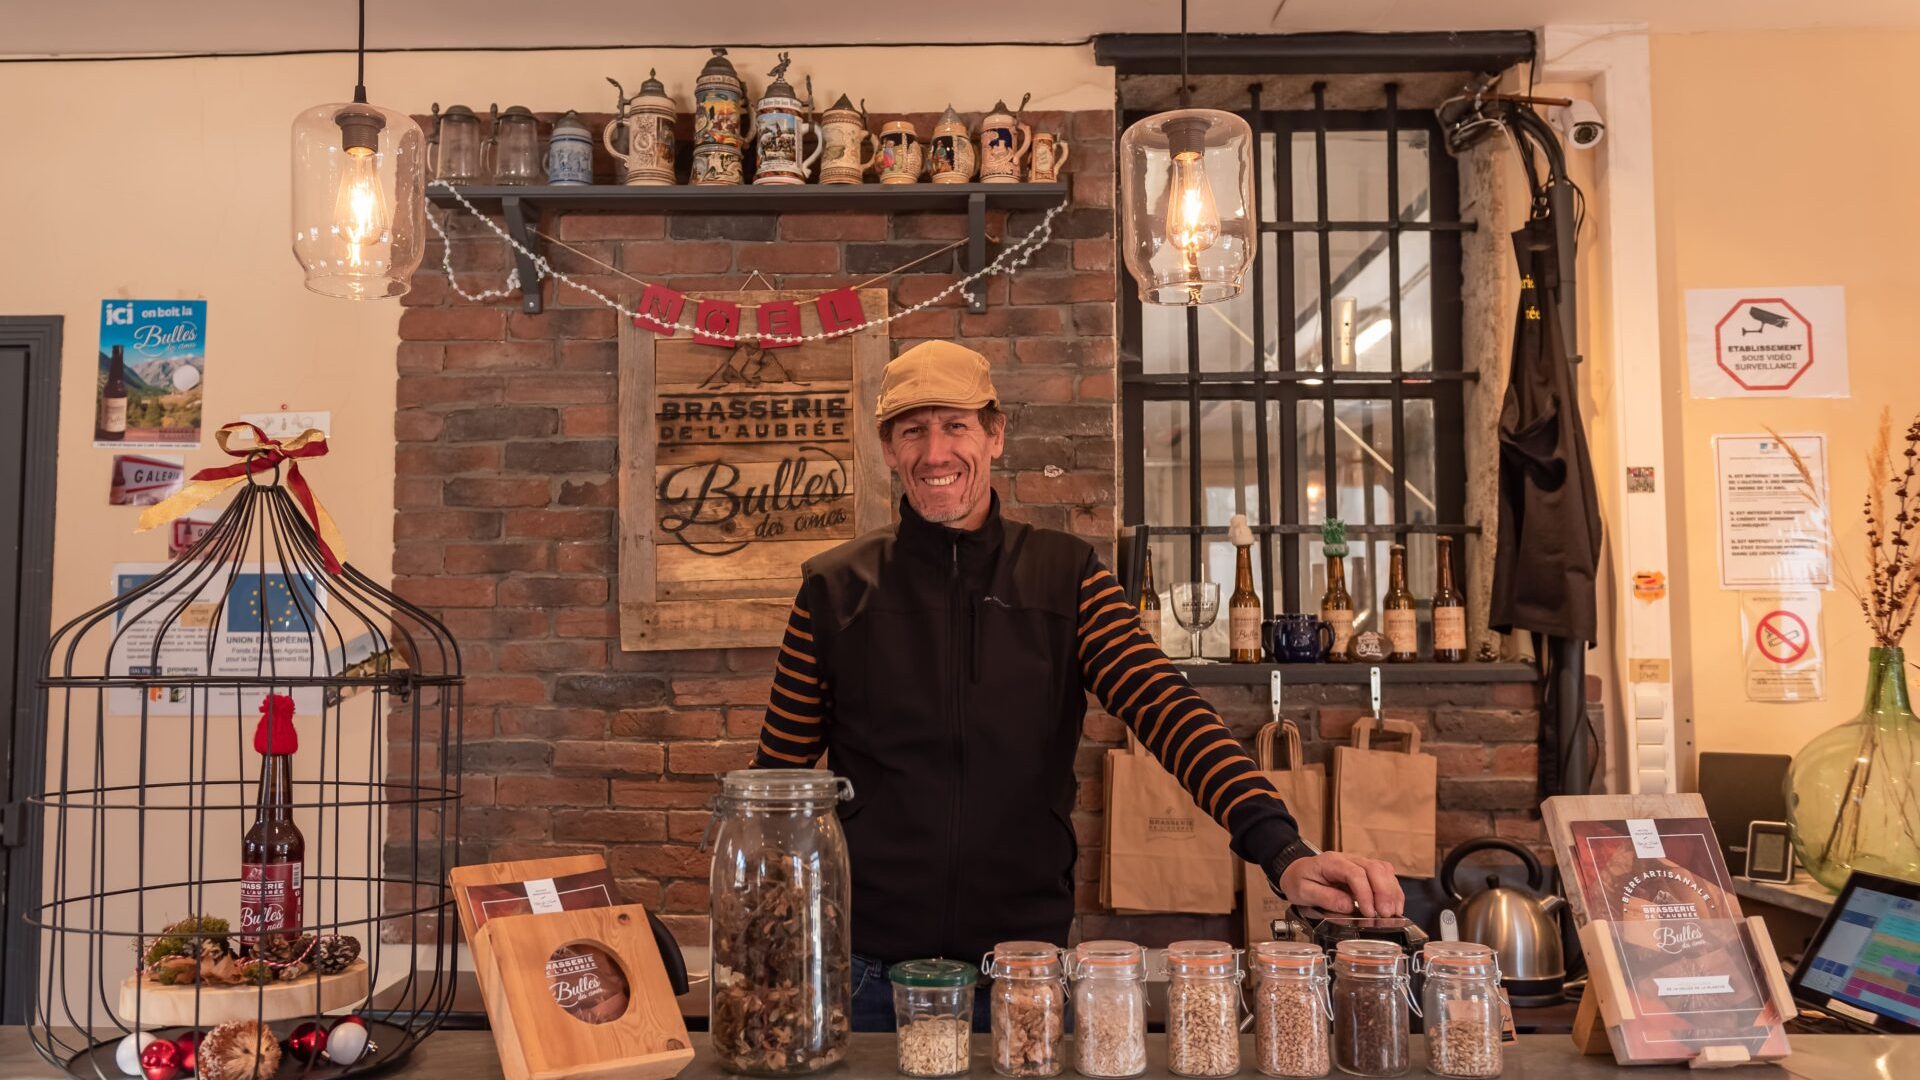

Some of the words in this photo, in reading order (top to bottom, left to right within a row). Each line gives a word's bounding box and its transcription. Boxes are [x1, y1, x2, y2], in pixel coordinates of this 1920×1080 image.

[106, 302, 134, 326] ici
[141, 309, 156, 318] on
[157, 306, 180, 318] boit
[182, 305, 193, 316] la
[133, 324, 198, 350] Bulles
[1728, 344, 1802, 352] ETABLISSEMENT
[1735, 362, 1798, 371] SURVEILLANCE
[1766, 353, 1792, 361] VIDÉO
[661, 397, 846, 423] BRASSERIE
[660, 425, 693, 440] DE
[708, 420, 845, 440] L'AUBRÉE
[659, 456, 847, 534] Bulles
[755, 514, 785, 539] des
[226, 636, 253, 644] UNION
[256, 635, 315, 644] EUOPÉENN
[241, 882, 284, 890] BRASSRIE
[1622, 876, 1641, 903] BIÈRE
[1643, 869, 1711, 901] ARTISANALE
[1643, 905, 1696, 914] BRASSERIE
[1653, 924, 1703, 949] Bulles
[545, 956, 594, 970] RASSERIE
[549, 976, 600, 1003] Bulles
